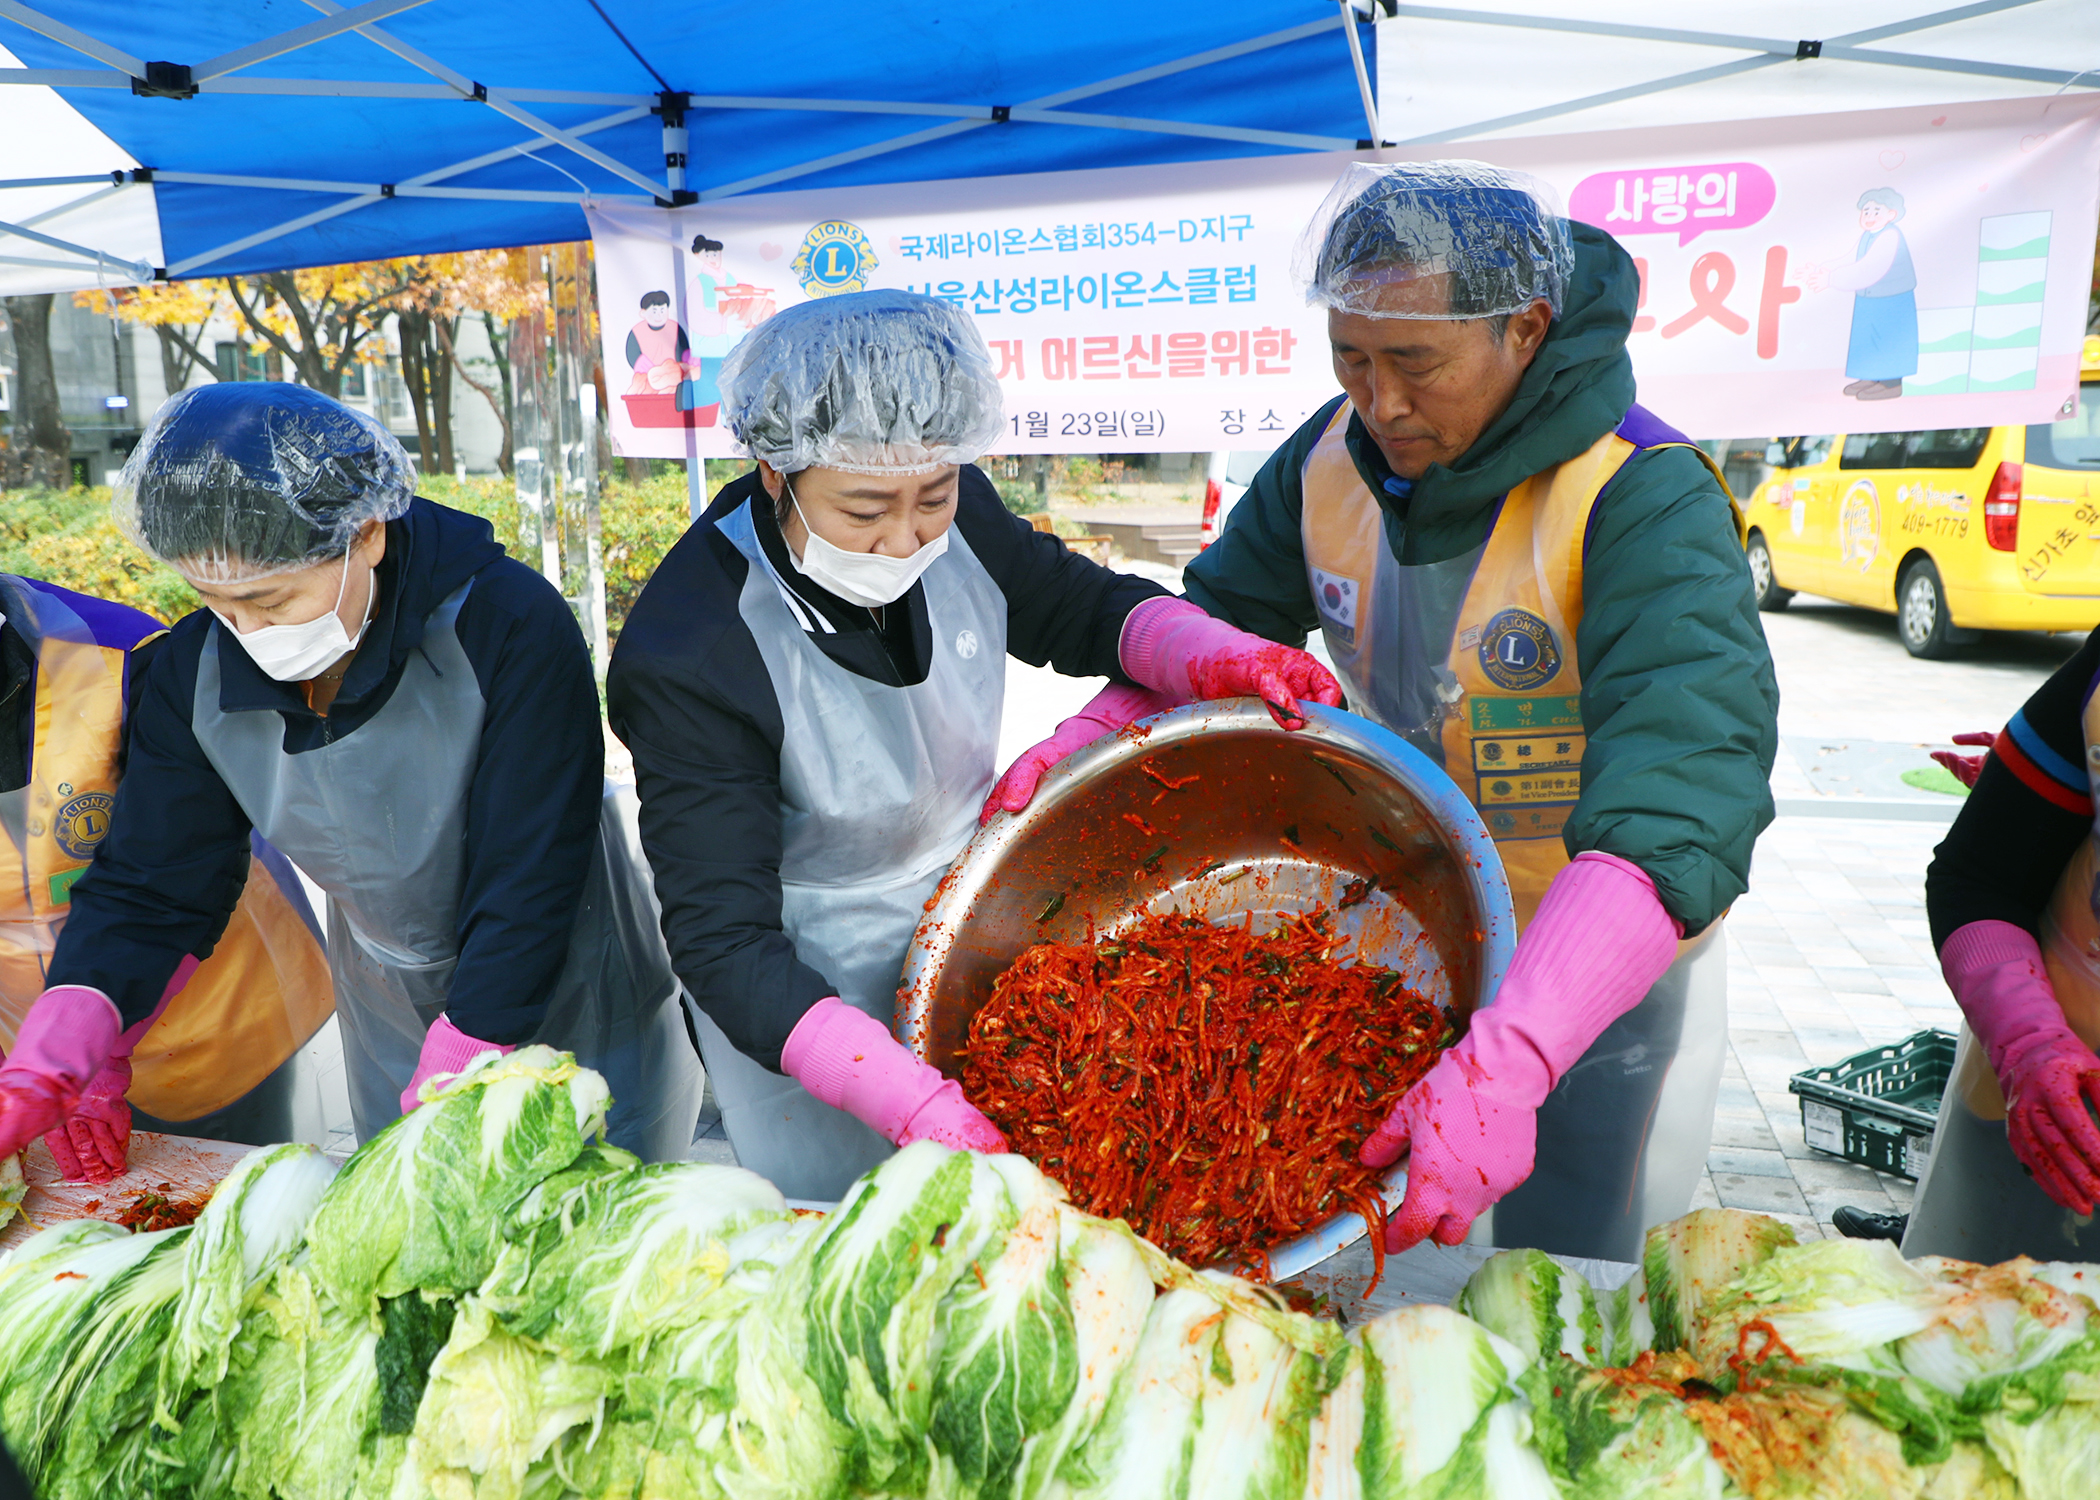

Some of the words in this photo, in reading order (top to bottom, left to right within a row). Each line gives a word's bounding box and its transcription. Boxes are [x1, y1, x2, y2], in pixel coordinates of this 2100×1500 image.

[1605, 171, 1738, 225] 사랑의
[811, 223, 859, 243] LIONS
[900, 214, 1255, 262] 국제라이온스협회354-D지구
[825, 247, 847, 276] L
[1041, 326, 1298, 381] 어르신을위한
[1061, 409, 1166, 438] 23일(일)
[1902, 514, 1970, 539] 409-1779
[1503, 618, 1541, 637] LIONS
[1504, 635, 1525, 665] L
[1519, 760, 1571, 770] SECRETARY
[68, 798, 108, 816] LIONS
[84, 815, 103, 836] L
